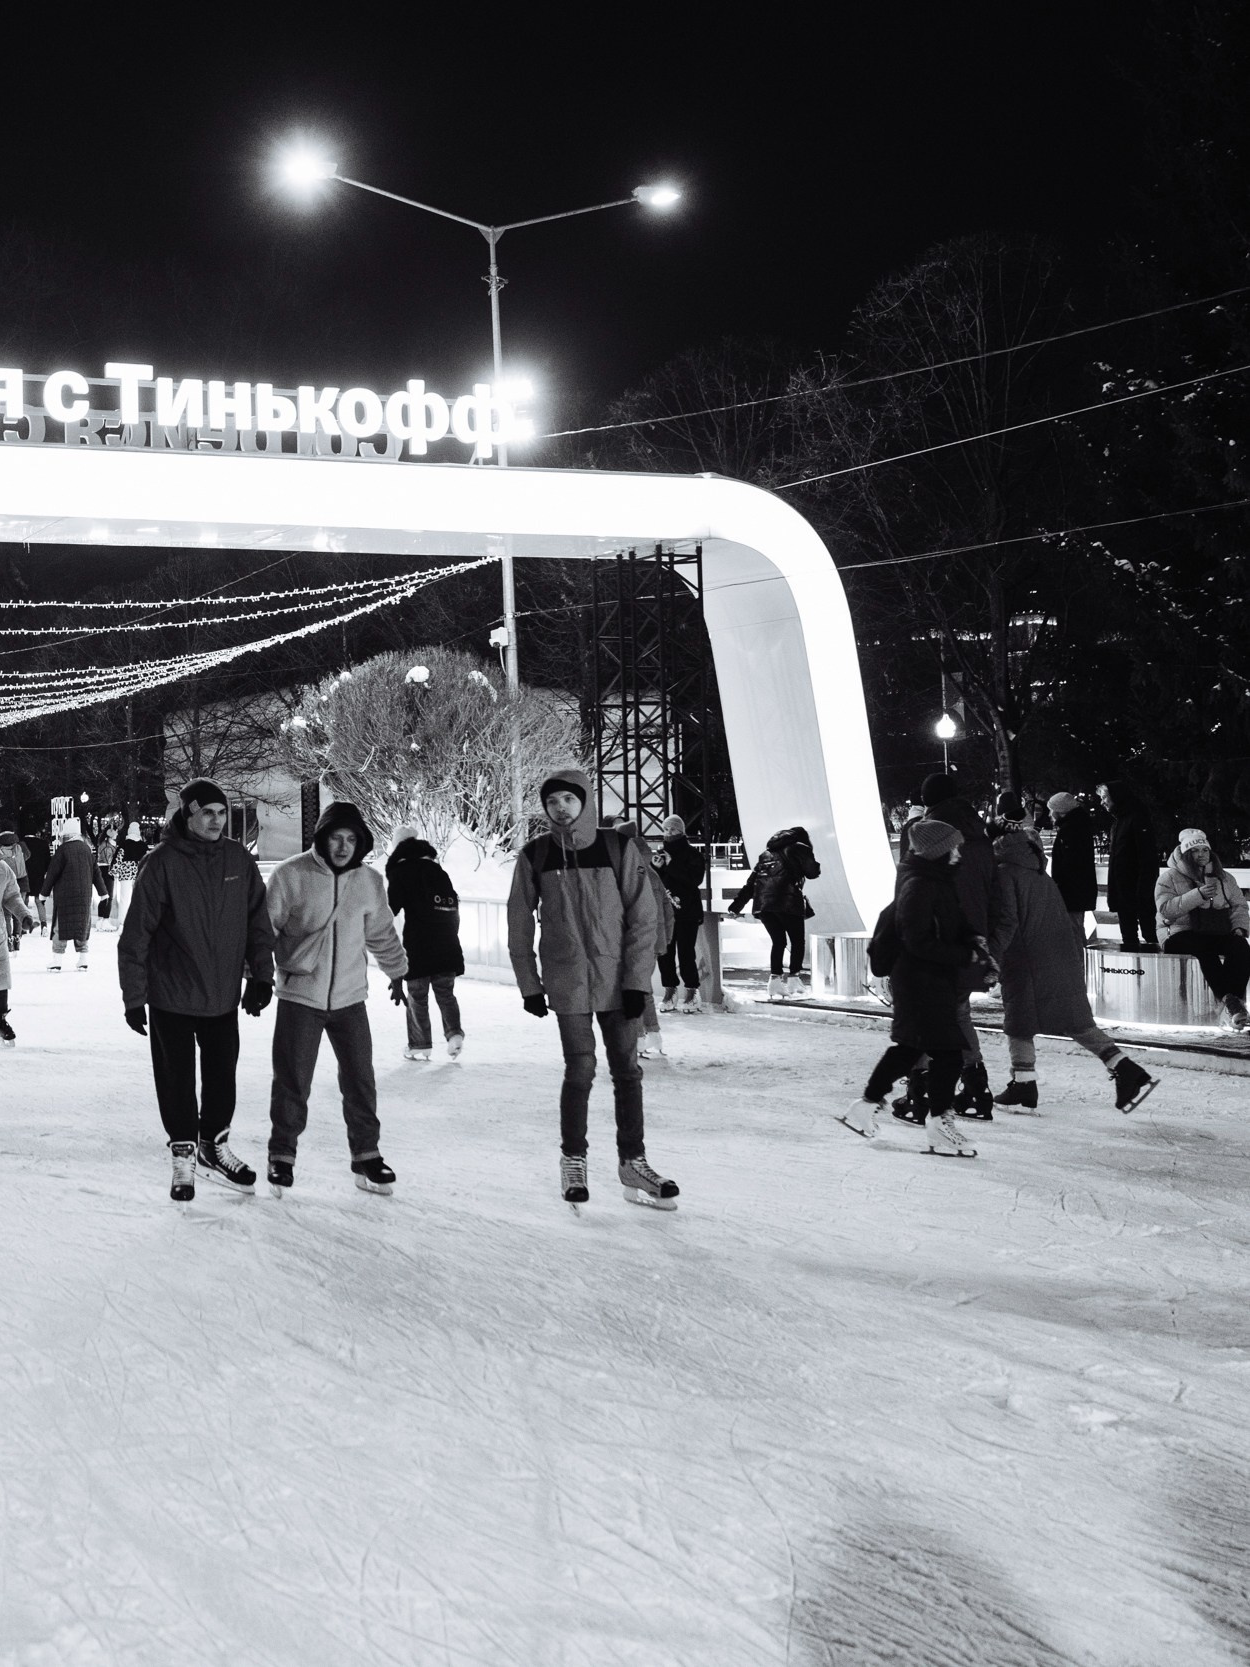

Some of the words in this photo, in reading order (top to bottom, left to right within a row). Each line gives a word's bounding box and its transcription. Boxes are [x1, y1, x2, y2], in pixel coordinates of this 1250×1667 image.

[43, 370, 90, 422] с
[104, 363, 515, 458] Тинькофф
[1100, 966, 1145, 976] ТИНЬКОФФ
